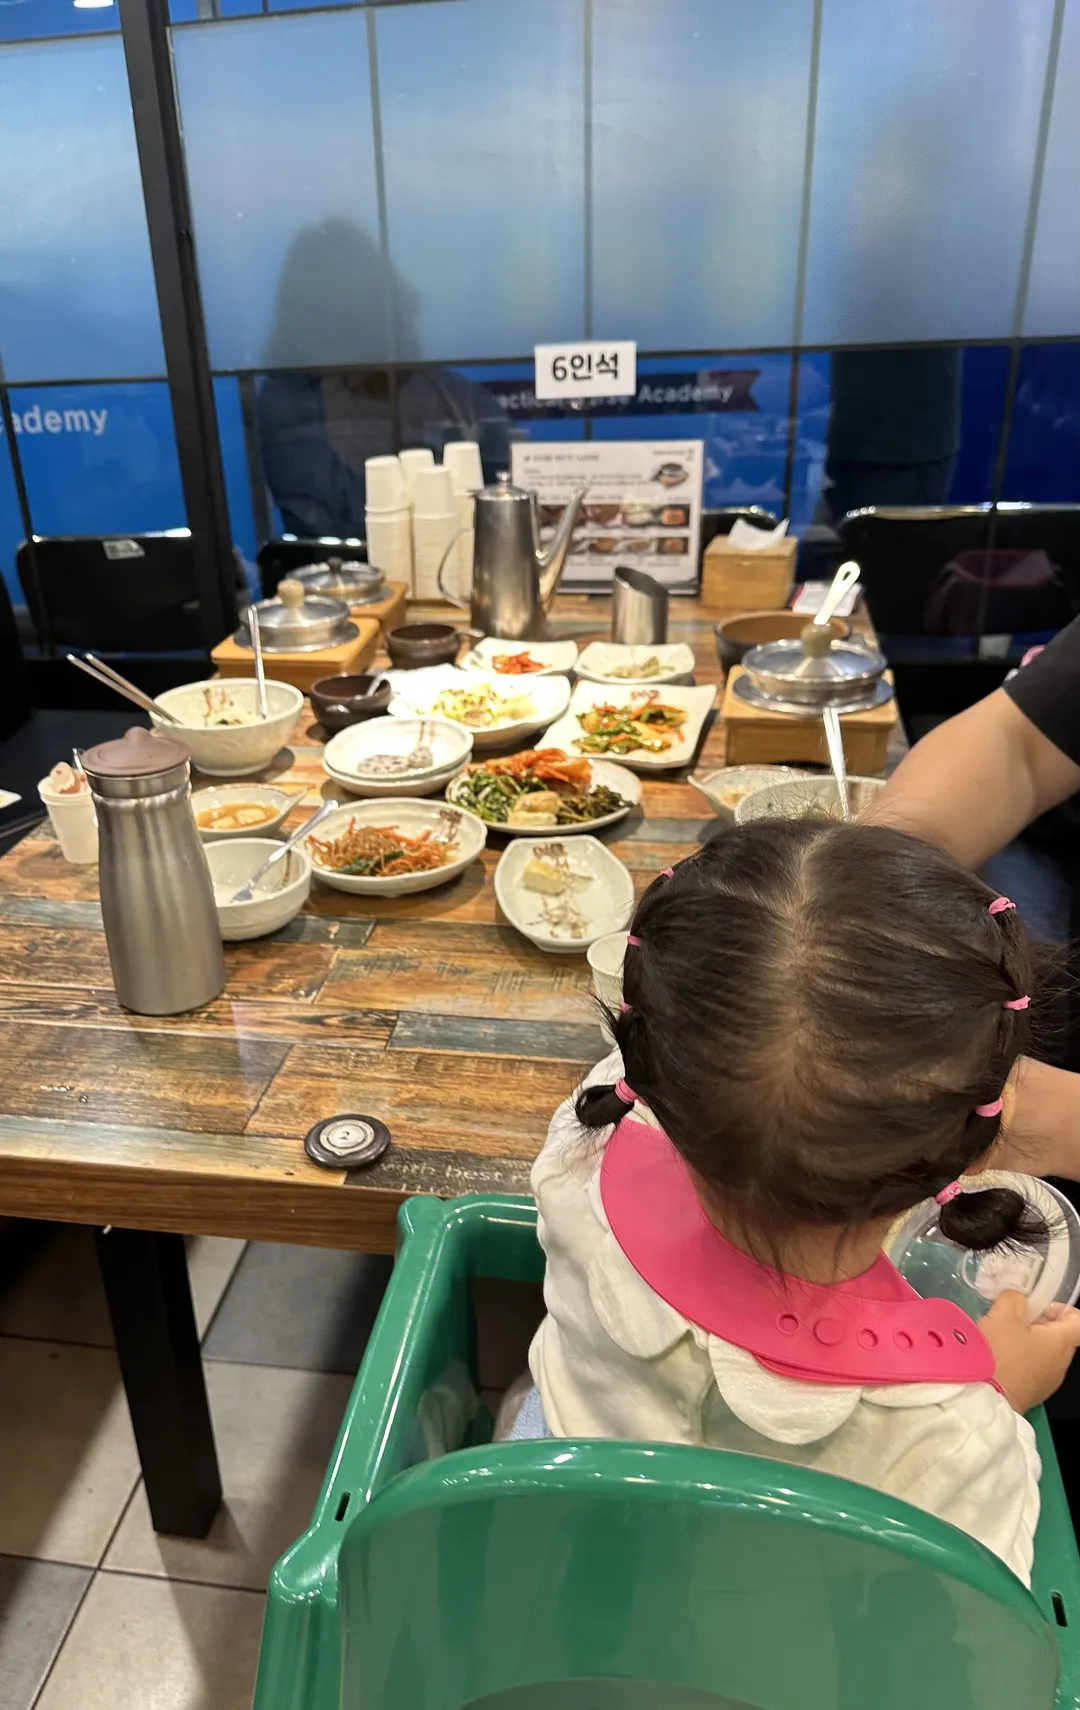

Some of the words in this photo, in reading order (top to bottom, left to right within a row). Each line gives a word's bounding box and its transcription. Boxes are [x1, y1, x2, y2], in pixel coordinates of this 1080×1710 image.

[552, 352, 619, 382] 6인석
[637, 384, 735, 404] Academy
[0, 404, 108, 437] ademy
[445, 1164, 504, 1183] best
